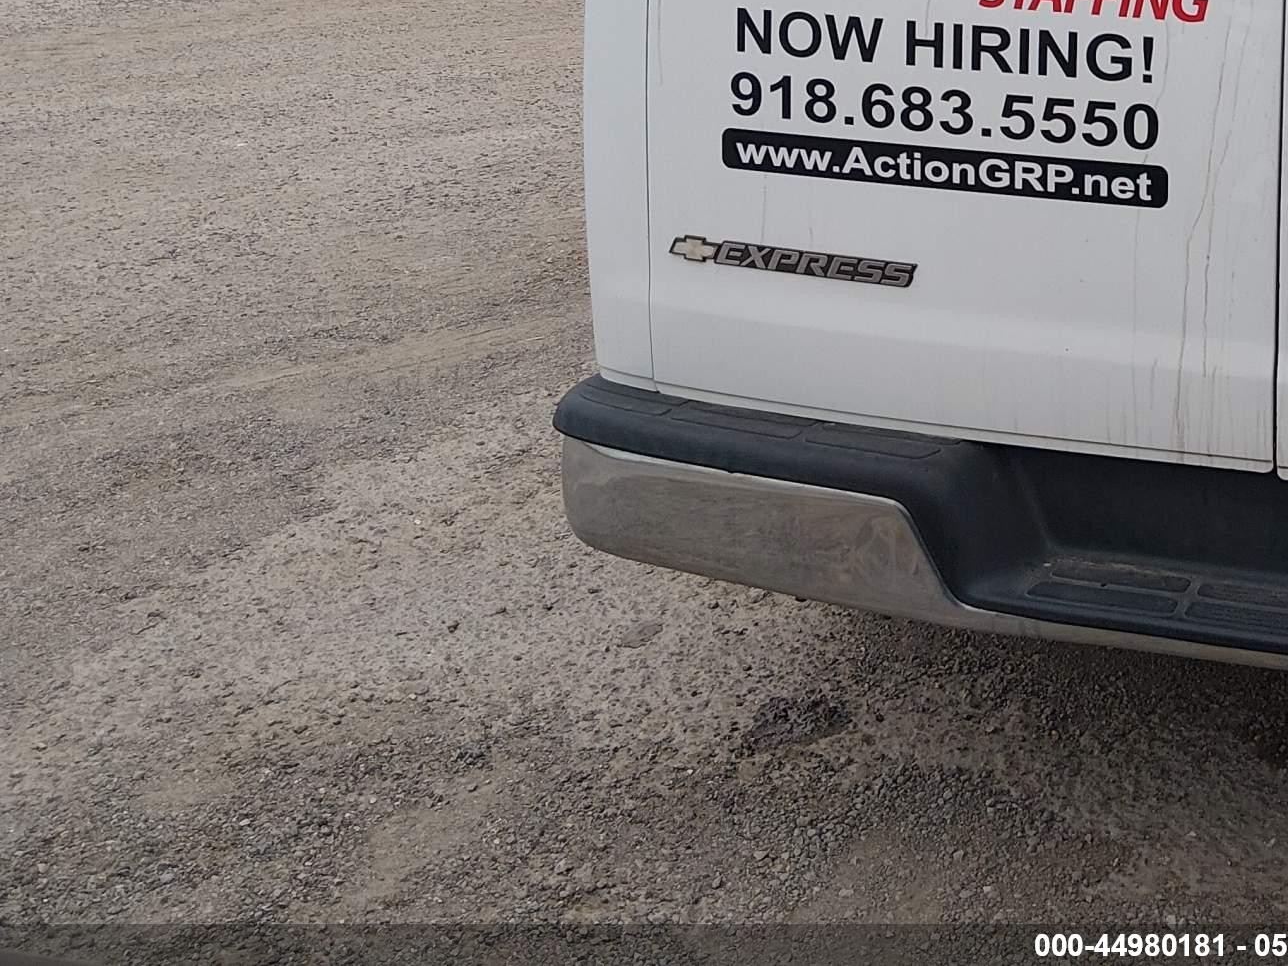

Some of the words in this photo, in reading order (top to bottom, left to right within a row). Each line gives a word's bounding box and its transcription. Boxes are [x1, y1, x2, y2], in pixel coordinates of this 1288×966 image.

[735, 7, 884, 63] NOW
[904, 19, 1155, 84] HIRING!
[729, 71, 1160, 150] 918.683.5550
[735, 139, 1152, 202] www.ActionGRP.net
[714, 240, 914, 287] EXPRESS
